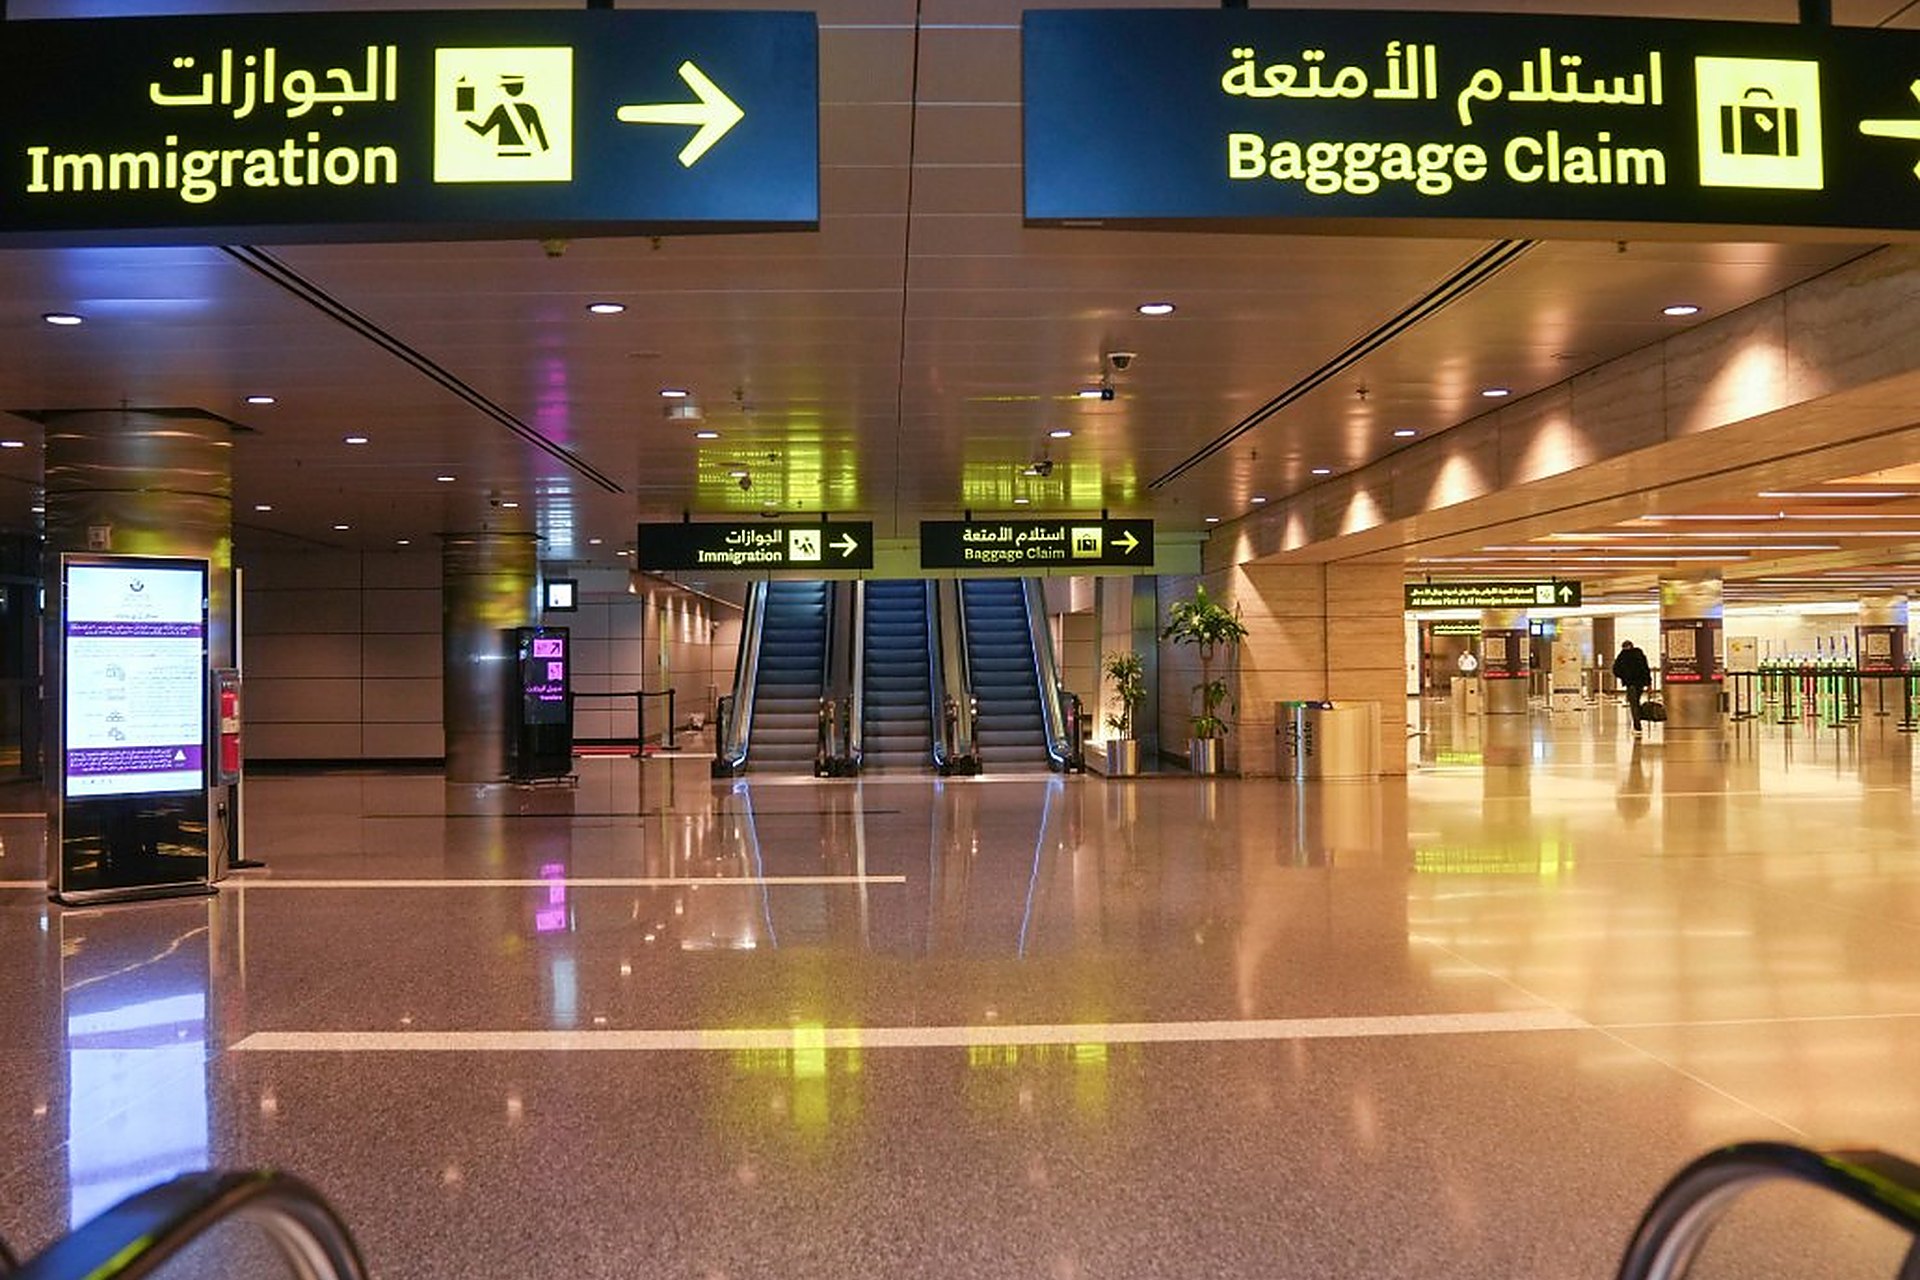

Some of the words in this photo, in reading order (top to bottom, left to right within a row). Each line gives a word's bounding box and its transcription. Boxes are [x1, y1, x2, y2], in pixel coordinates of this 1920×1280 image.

[149, 45, 397, 119] الجوازات
[1221, 40, 1437, 100] الأمتعة
[1457, 48, 1662, 126] استلام
[26, 131, 397, 204] Immigration
[1228, 132, 1488, 196] Baggage
[1504, 129, 1666, 186] Claim
[698, 548, 782, 565] Immigration
[725, 529, 782, 546] الجوازات
[964, 547, 1024, 563] Baggage
[1026, 546, 1064, 559] Claim
[1015, 526, 1064, 546] استلام
